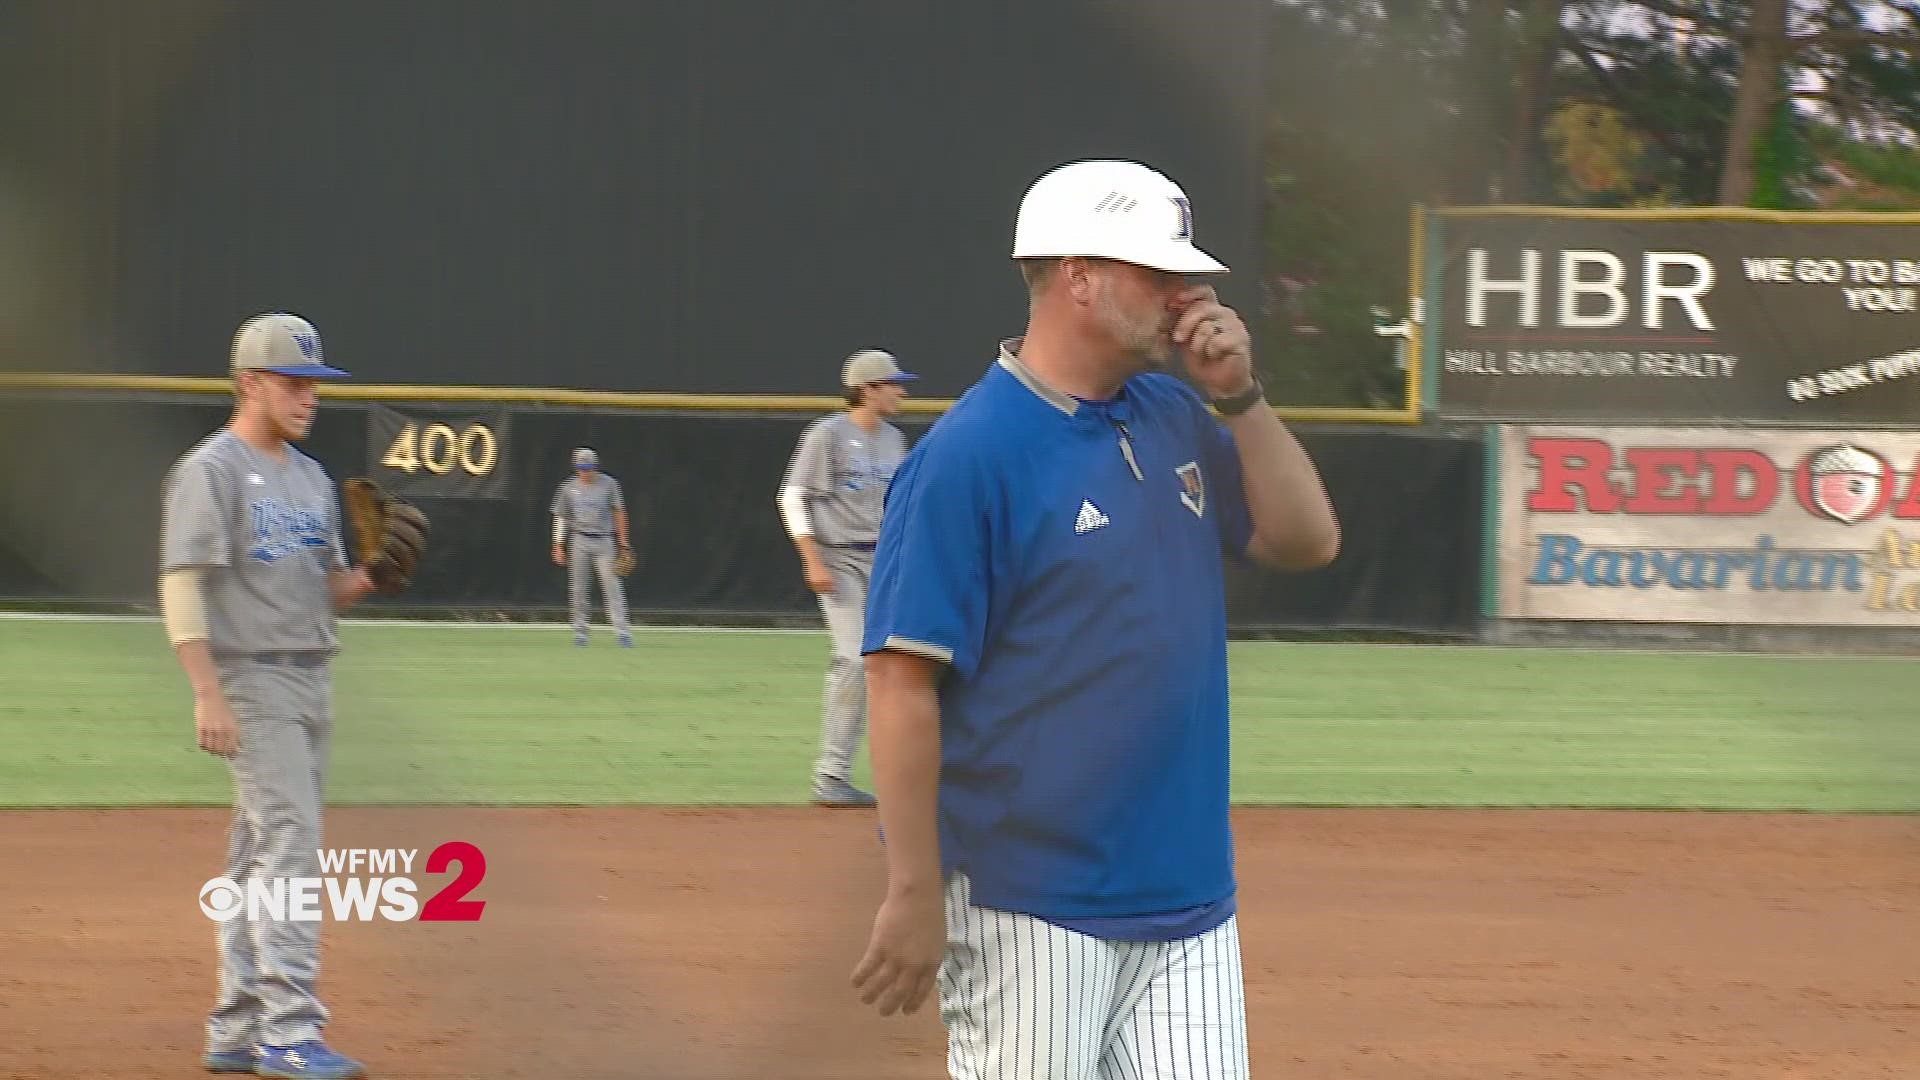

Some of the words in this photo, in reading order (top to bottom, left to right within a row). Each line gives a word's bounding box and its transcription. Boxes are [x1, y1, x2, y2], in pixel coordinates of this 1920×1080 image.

[1465, 249, 1717, 331] HBR
[1742, 258, 1794, 281] WE
[1795, 258, 1844, 283] GO
[1845, 259, 1890, 283] TO
[1842, 287, 1918, 312] YOU!
[1445, 349, 1502, 375] HILL
[1506, 350, 1635, 377] BARBOUR
[1638, 351, 1738, 379] REALTY
[381, 420, 498, 476] 400
[1528, 436, 1779, 516] RED
[1529, 532, 1864, 592] Bavarian
